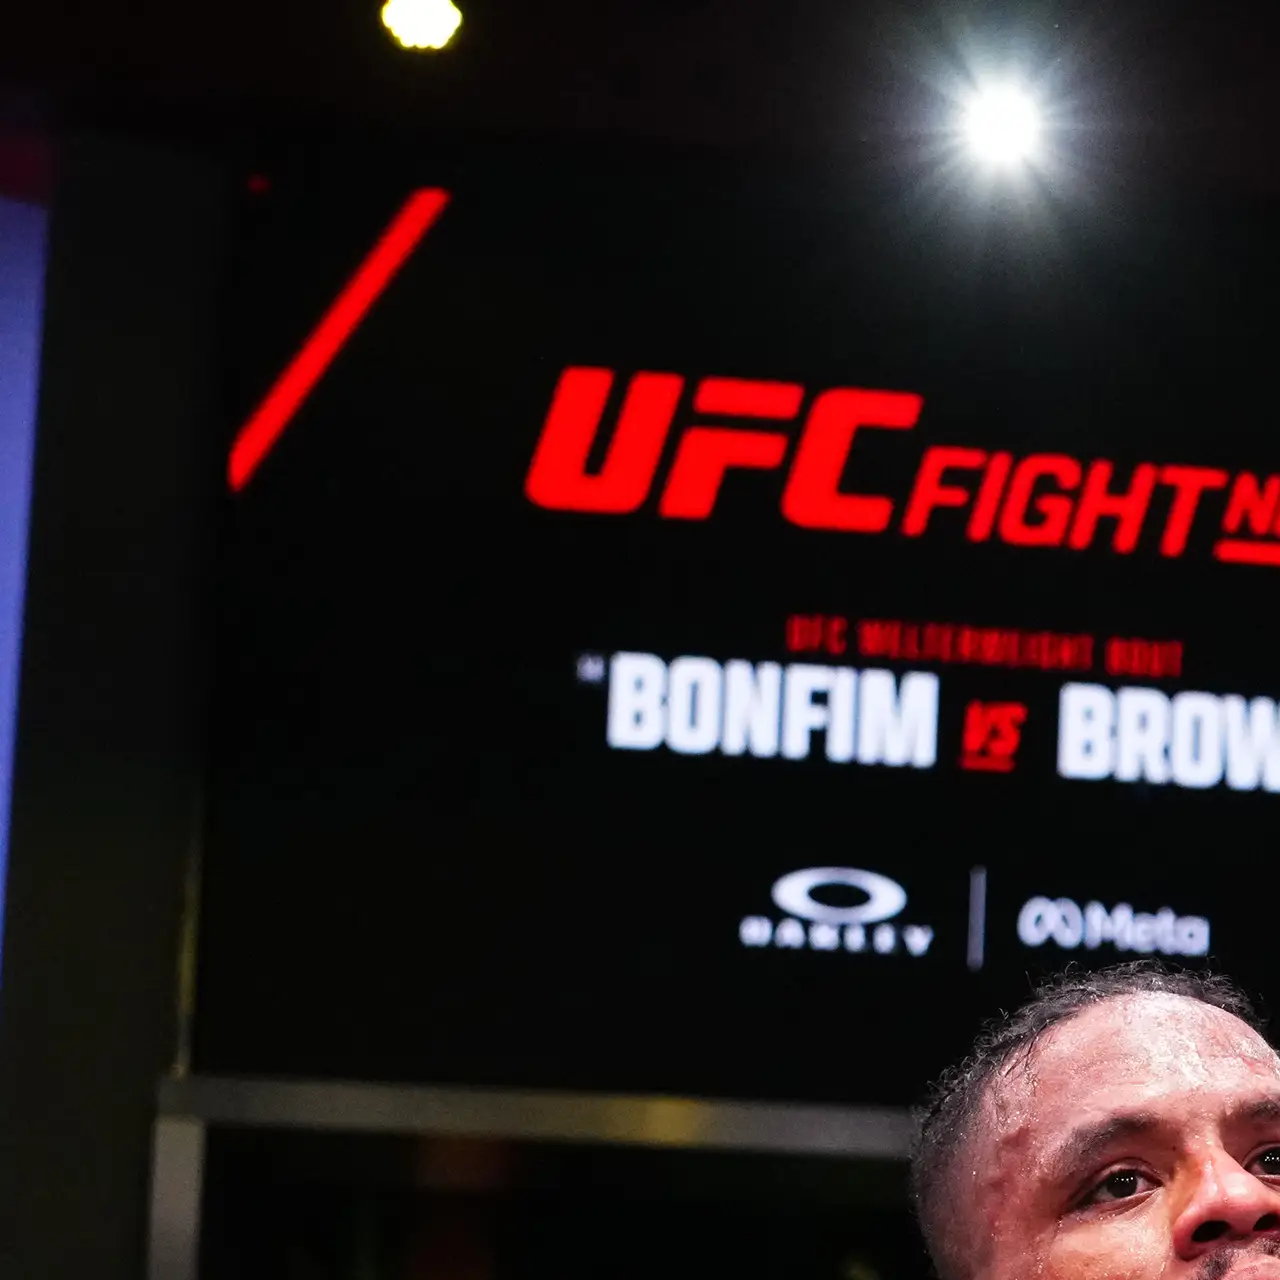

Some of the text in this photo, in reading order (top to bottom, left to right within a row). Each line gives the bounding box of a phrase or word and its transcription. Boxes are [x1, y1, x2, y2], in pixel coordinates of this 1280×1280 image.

[525, 366, 924, 532] UFC
[902, 447, 1228, 557] FIGHT
[607, 652, 939, 768] BONFIM
[963, 701, 1027, 758] VS
[739, 916, 933, 956] OAKLEY
[1085, 902, 1210, 956] Meta
